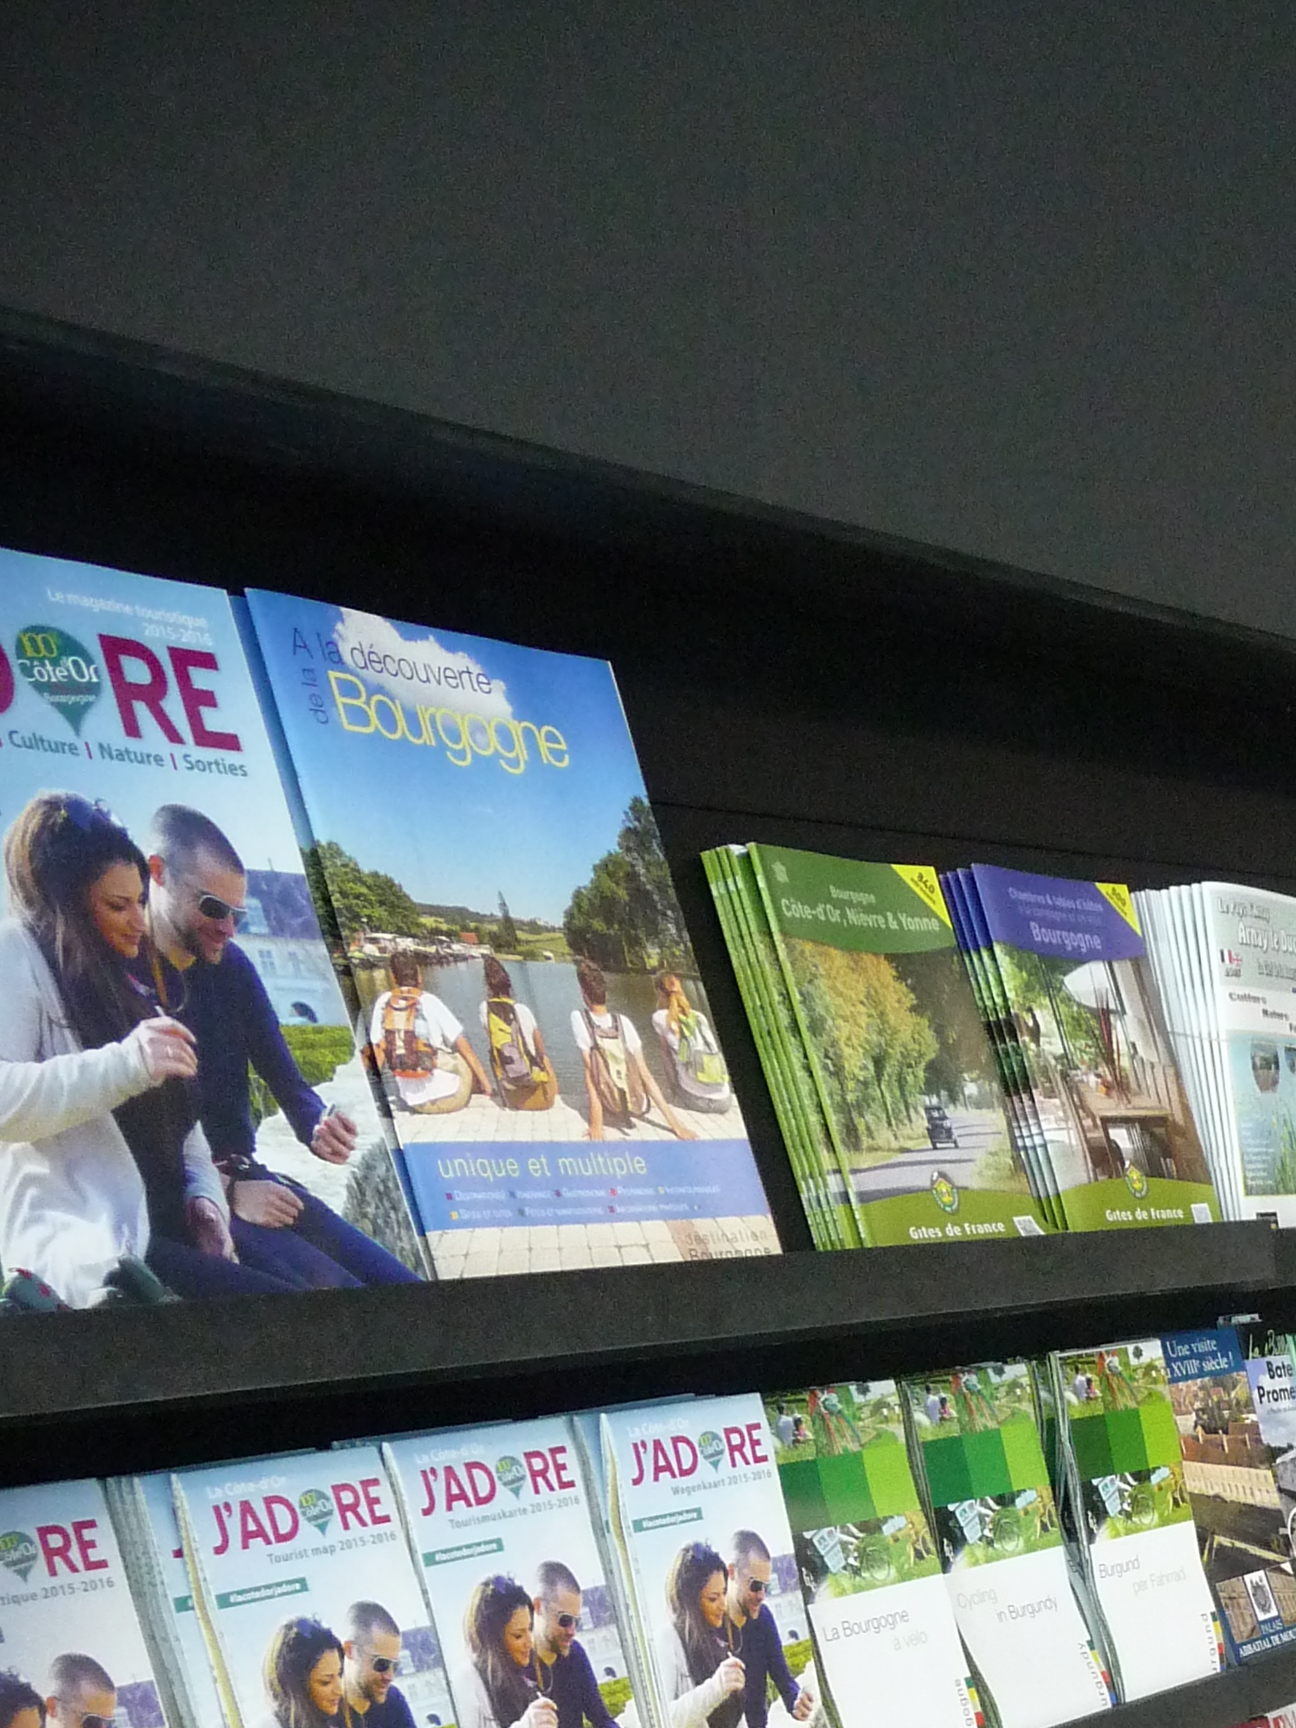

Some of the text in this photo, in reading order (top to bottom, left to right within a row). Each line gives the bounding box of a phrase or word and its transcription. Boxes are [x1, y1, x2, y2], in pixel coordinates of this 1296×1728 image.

[316, 632, 344, 665] la
[349, 642, 493, 695] découverte
[328, 671, 570, 775] Bourgogne
[8, 730, 249, 779] Culture Nature Sorties
[829, 885, 876, 905] Bourgogne
[848, 905, 886, 931] Nièvre
[886, 913, 899, 930] &
[899, 913, 941, 933] Yonne
[1029, 920, 1102, 953] Bourgogne
[438, 1150, 648, 1182] unique et multiple
[1134, 1206, 1185, 1221] de France
[942, 1219, 1006, 1238] de France
[1166, 1337, 1218, 1358] Une visite
[1202, 1354, 1228, 1373] siècle
[207, 1485, 222, 1500] La
[671, 1468, 773, 1498] Wegenkaart 2015-2016
[448, 1494, 581, 1530] Tourismuskarte 2015-2016
[266, 1529, 398, 1566] Tourist map 2015-2016
[1098, 1555, 1141, 1580] Burgund
[1150, 1567, 1188, 1591] Fahrrad
[41, 1576, 115, 1600] 2015-2016
[1009, 1594, 1059, 1622] Burgundy
[822, 1608, 910, 1644] La Bourgogne
[1077, 1641, 1109, 1708] urgundy
